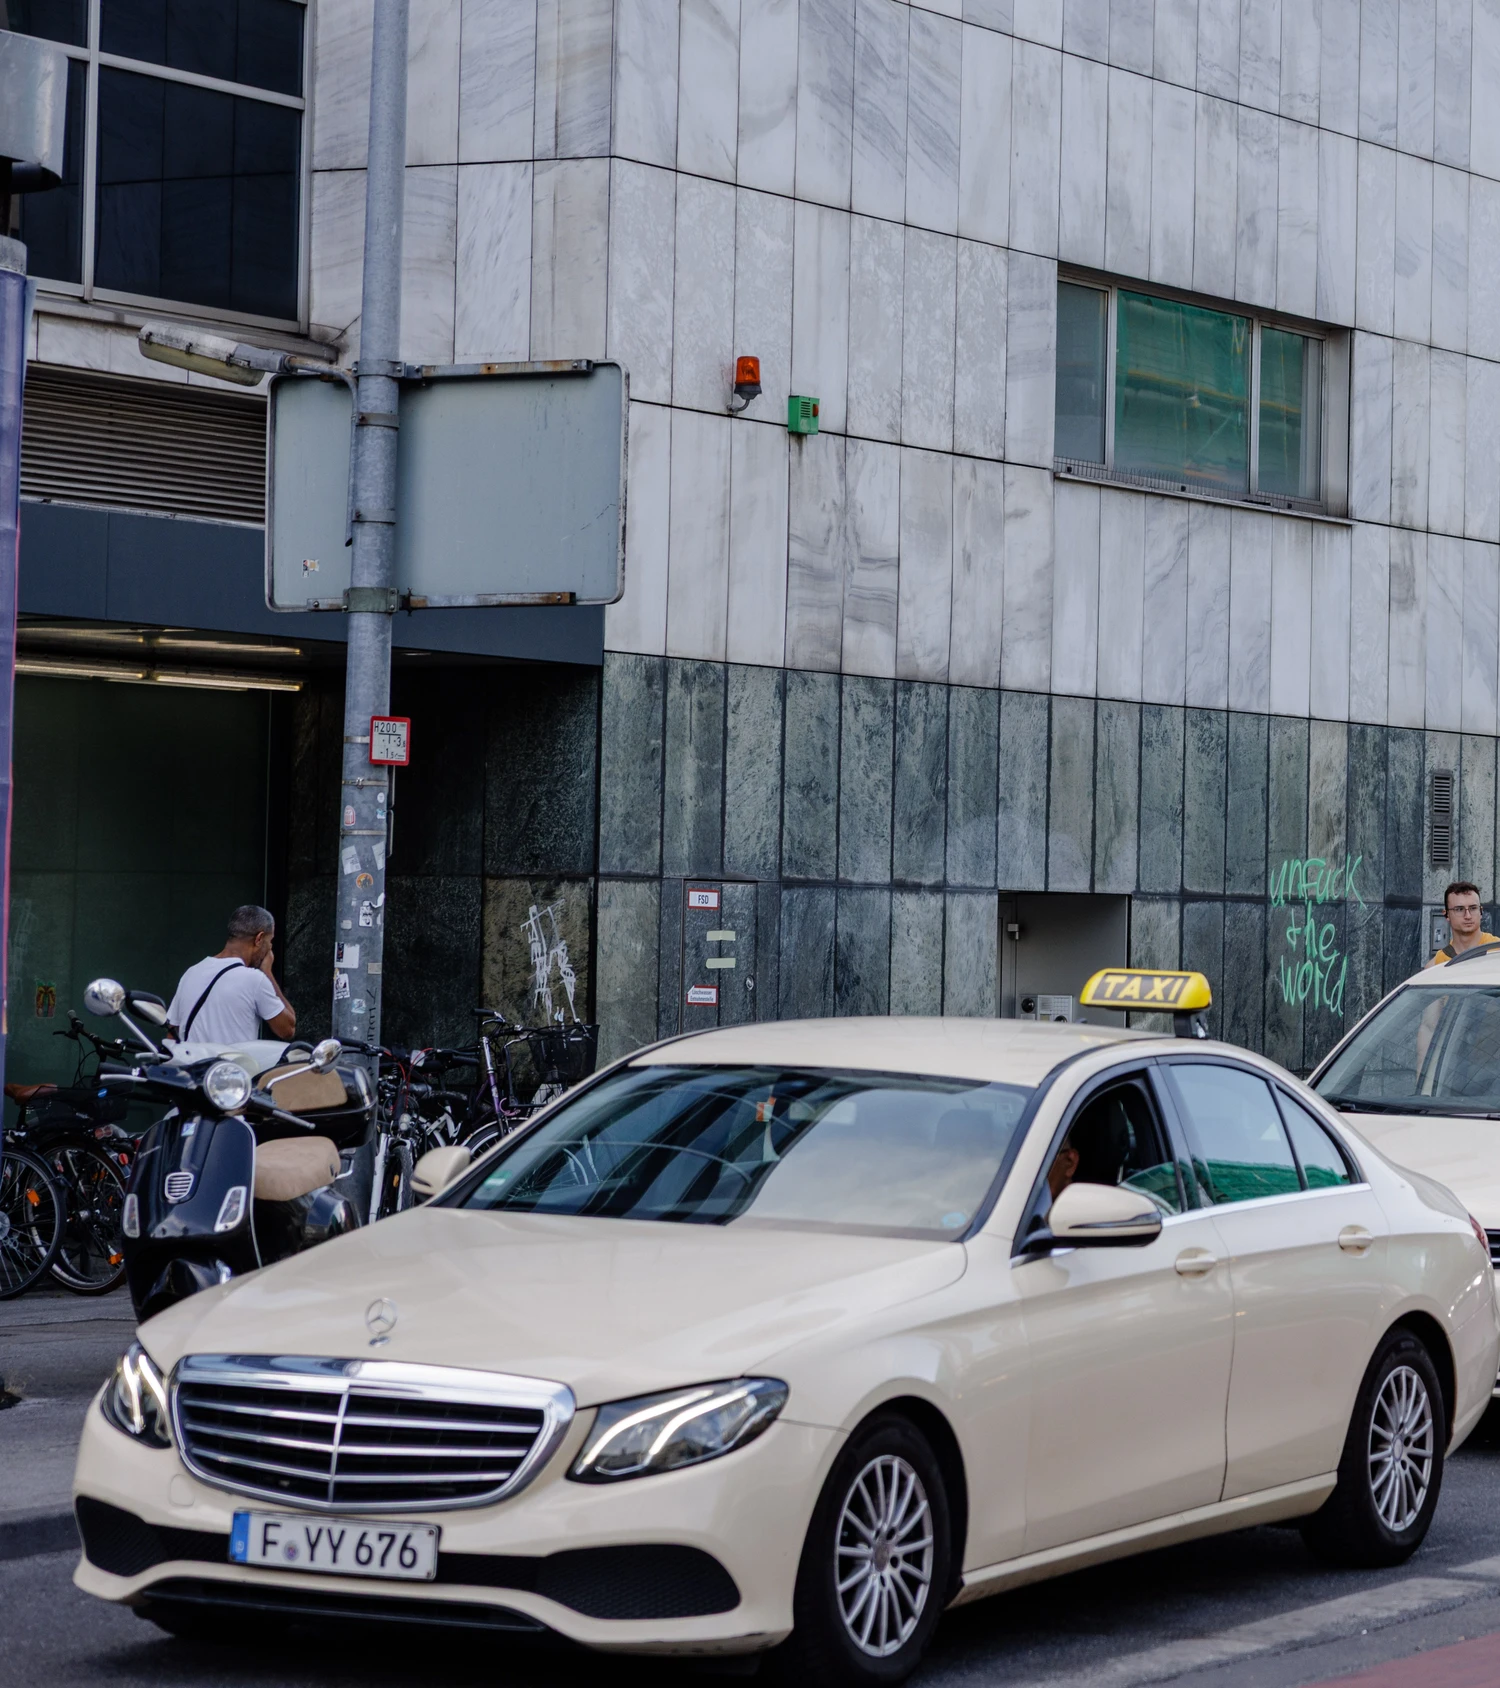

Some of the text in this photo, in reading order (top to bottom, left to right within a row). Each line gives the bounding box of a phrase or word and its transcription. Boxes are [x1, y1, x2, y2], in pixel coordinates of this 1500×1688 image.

[1103, 974, 1184, 1001] TAXI
[262, 1522, 417, 1569] F YY 676
